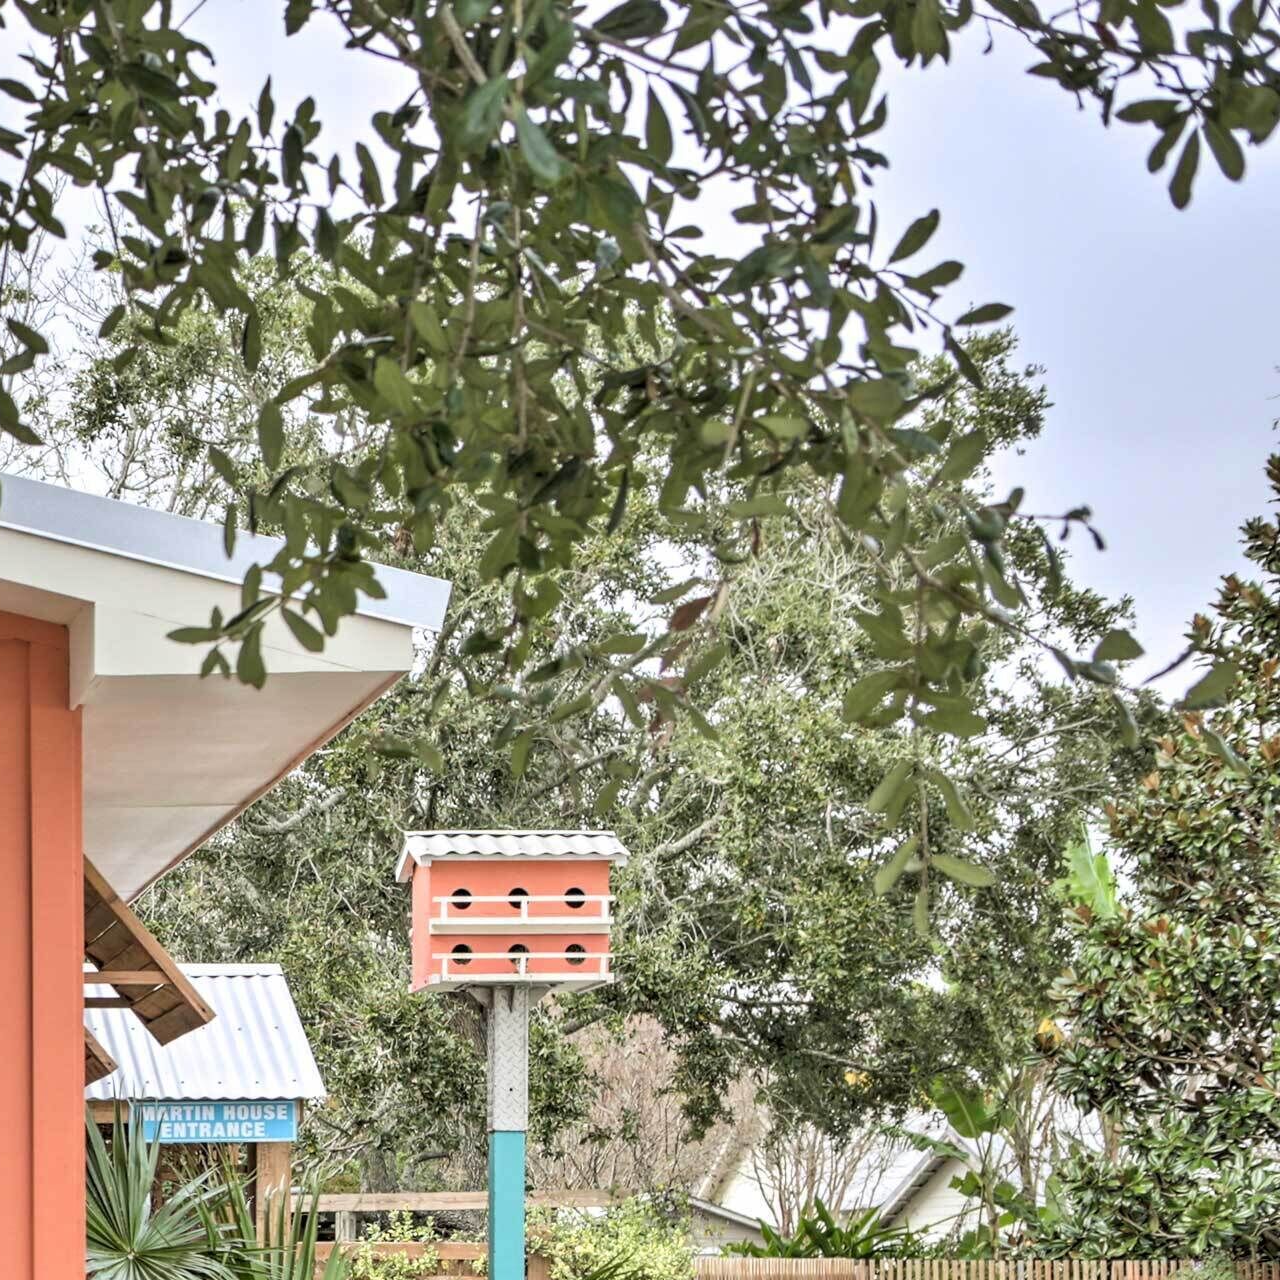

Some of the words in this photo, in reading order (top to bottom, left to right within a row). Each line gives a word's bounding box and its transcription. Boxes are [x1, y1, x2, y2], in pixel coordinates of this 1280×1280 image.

[142, 1105, 215, 1121] MARTIN
[223, 1104, 288, 1121] HOUSE
[160, 1122, 266, 1137] ENTRANCE
